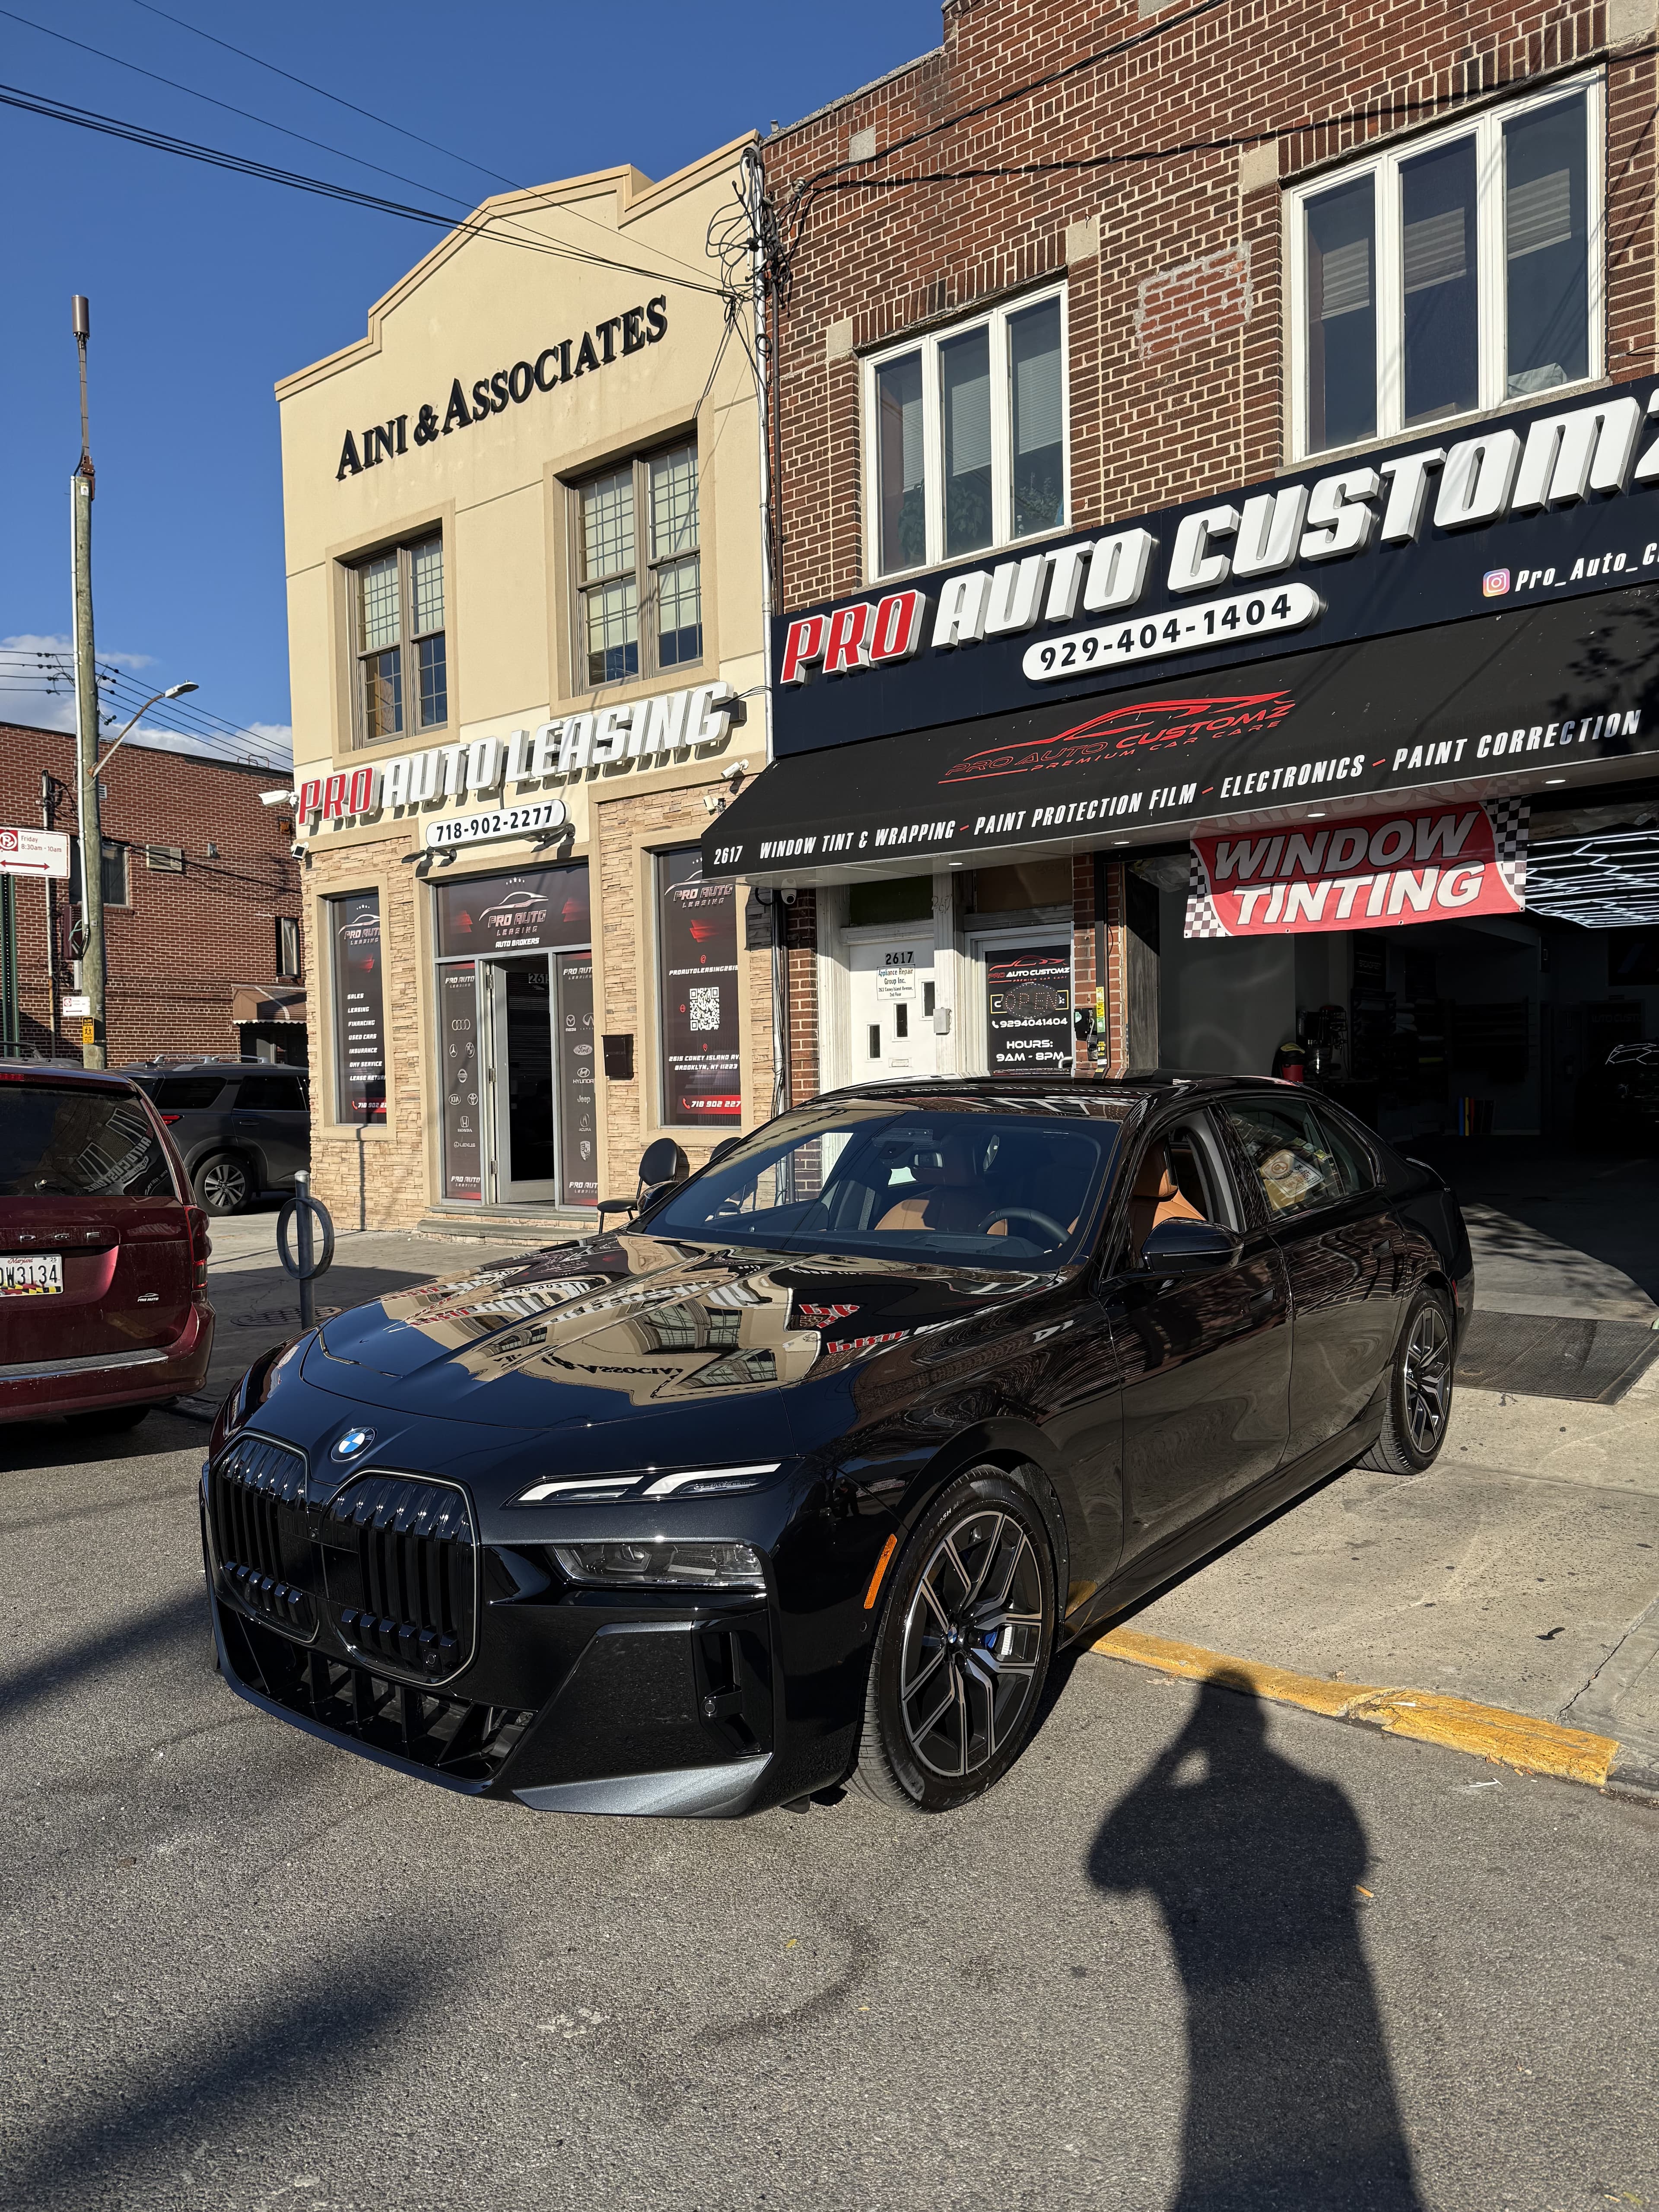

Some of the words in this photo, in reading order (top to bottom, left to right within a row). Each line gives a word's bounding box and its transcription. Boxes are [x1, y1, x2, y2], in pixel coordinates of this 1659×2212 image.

[335, 413, 409, 482] AINI
[440, 294, 667, 436] ASSOCIATES
[1515, 543, 1659, 592] Pro_Auto_C
[780, 588, 926, 686] PRO
[931, 527, 1152, 649] AUTO
[1040, 593, 1291, 671] 929-404-1404
[945, 756, 1014, 776] PRO
[1014, 741, 1109, 766] AUTO
[1115, 700, 1296, 749] CUSTOMZ
[1030, 748, 1135, 772] PREMIUM
[1149, 737, 1196, 750] CAR
[1212, 719, 1282, 739] CARE
[299, 765, 381, 826] PRO
[382, 736, 504, 809] AUTO
[506, 680, 734, 783] LEASING
[760, 837, 817, 859] WINDOW
[822, 833, 854, 852] TINT
[858, 832, 868, 849] &
[875, 820, 956, 847] WRAPPING
[974, 810, 1026, 835] PAINT
[1032, 791, 1142, 828] PROTECTION
[1149, 782, 1197, 810] FILM
[1220, 754, 1365, 799] ELECTRONICS
[1392, 738, 1468, 772] PAINT
[1476, 710, 1641, 759] CORRECTION
[436, 805, 552, 842] 718-902-2277
[1213, 809, 1481, 881] WINDOW
[714, 845, 743, 864] 2617
[674, 888, 699, 901] PRO
[700, 884, 734, 898] AUTO
[1233, 861, 1485, 926] TINTING
[682, 898, 725, 908] LEASING
[487, 914, 512, 928] PRO
[514, 909, 547, 925] AUTO
[344, 930, 361, 940] PRO
[496, 925, 538, 937] LEASING
[495, 939, 511, 948] AUTO
[511, 937, 540, 947] BROKERS
[886, 951, 913, 965] 2617
[878, 969, 897, 977] Appliance
[1030, 967, 1070, 976] CUSTOMZ
[1005, 992, 1058, 1010] OPEN
[1000, 1018, 1068, 1028] 9294041404
[1006, 1040, 1053, 1049] HOURS:
[996, 1053, 1026, 1062] 9AM
[1036, 1052, 1065, 1061] 8PM
[577, 1095, 591, 1104] Jeep
